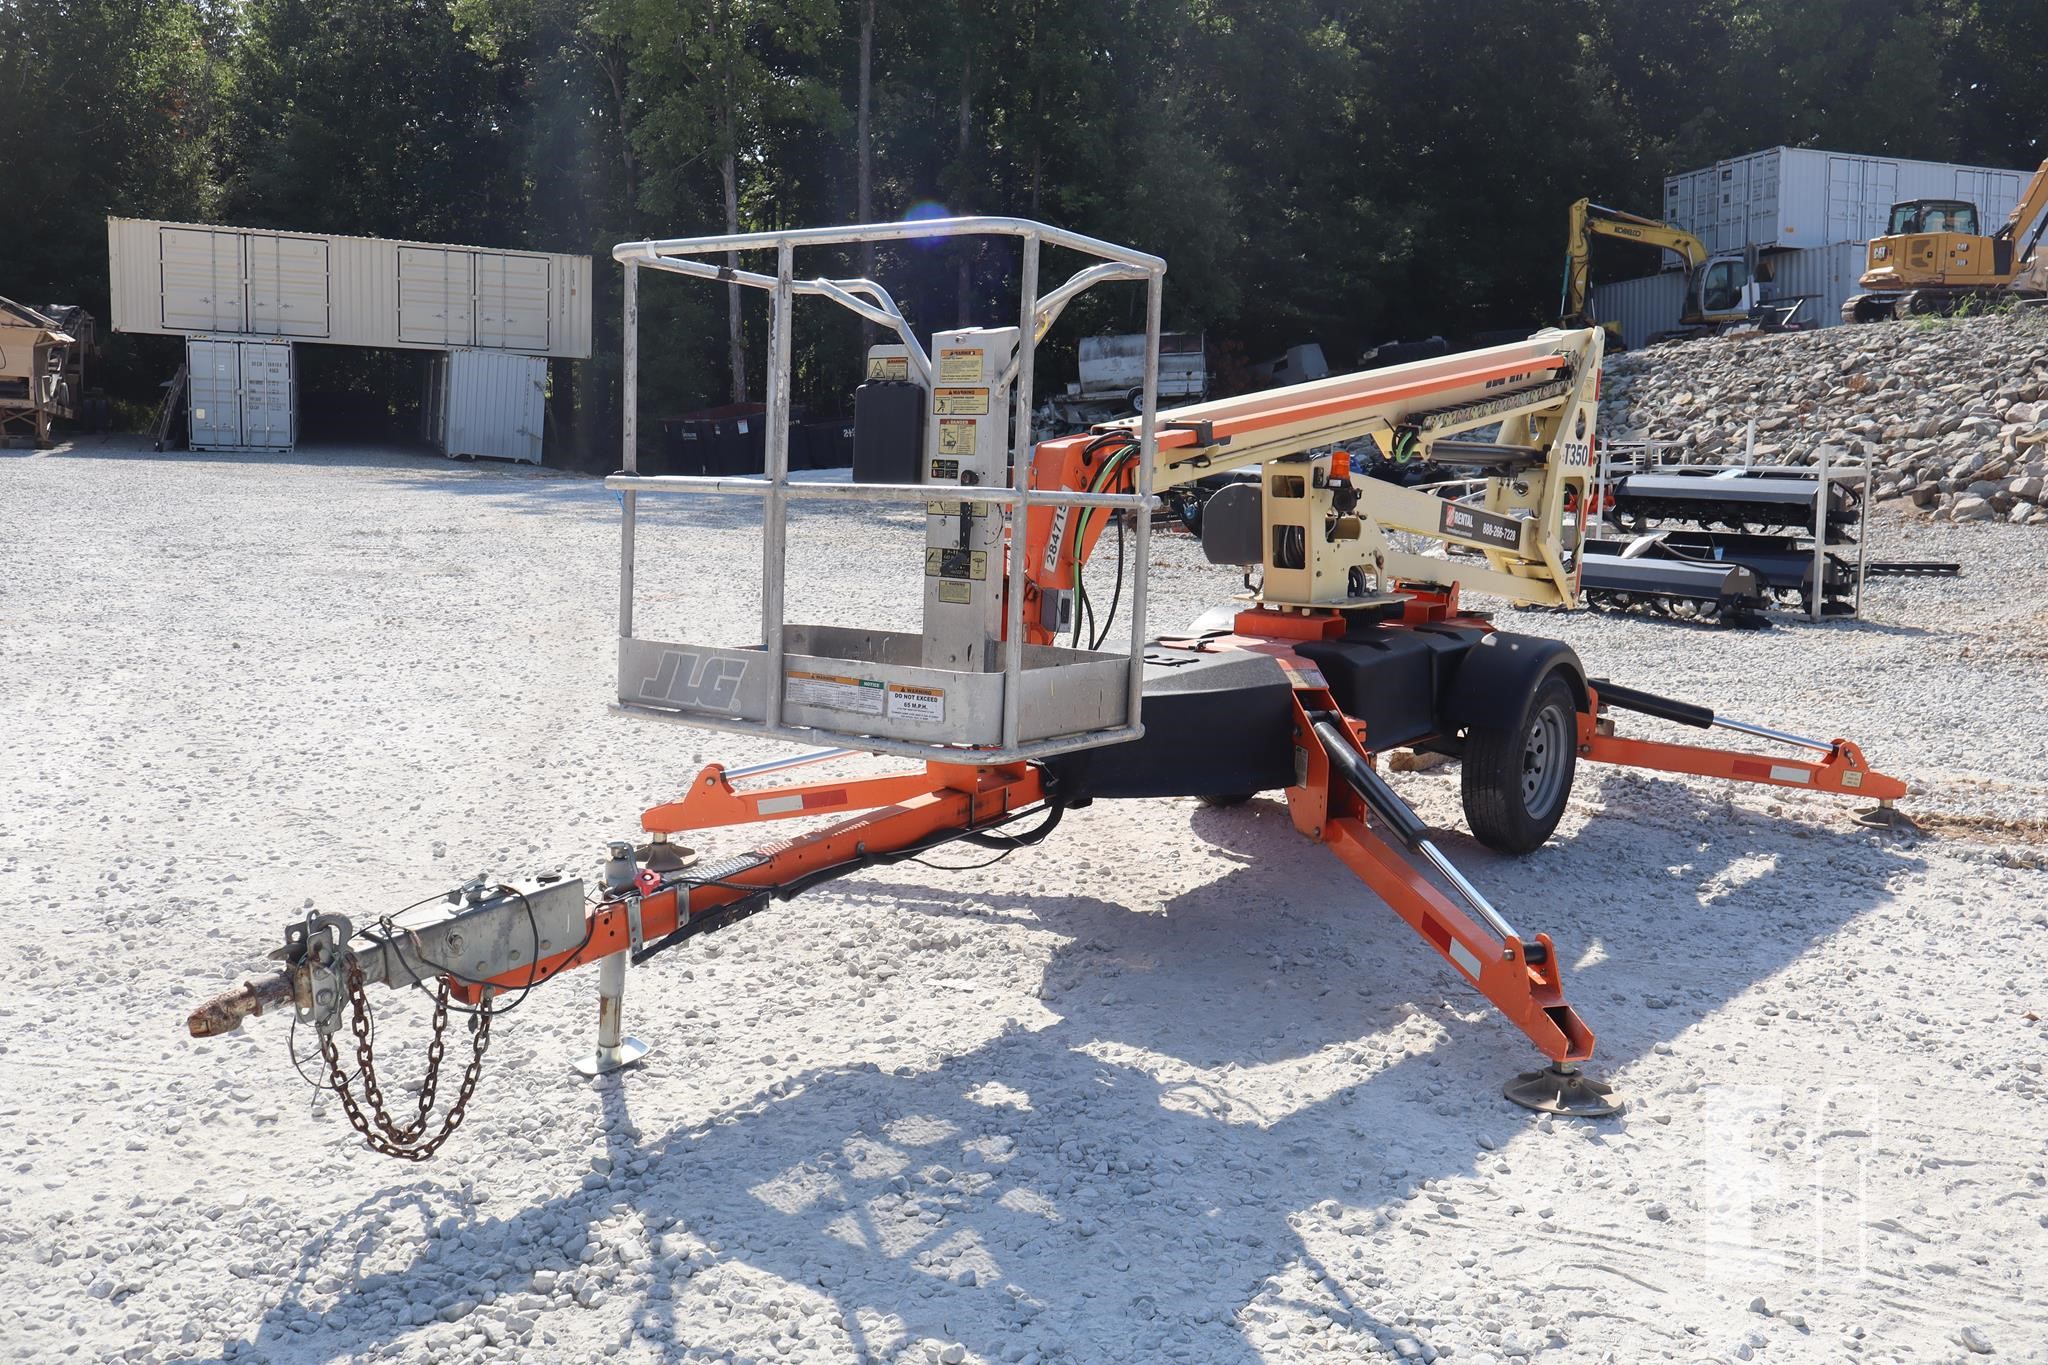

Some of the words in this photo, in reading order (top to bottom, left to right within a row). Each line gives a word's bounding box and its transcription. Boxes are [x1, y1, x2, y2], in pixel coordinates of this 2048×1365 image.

[1873, 246, 1887, 261] CAT
[1564, 443, 1588, 466] T350
[1454, 511, 1473, 528] RENTAL
[1482, 522, 1517, 542] 888-266-7228
[638, 650, 749, 711] JLG
[906, 688, 932, 696] WARNING
[916, 695, 938, 703] EXCEED
